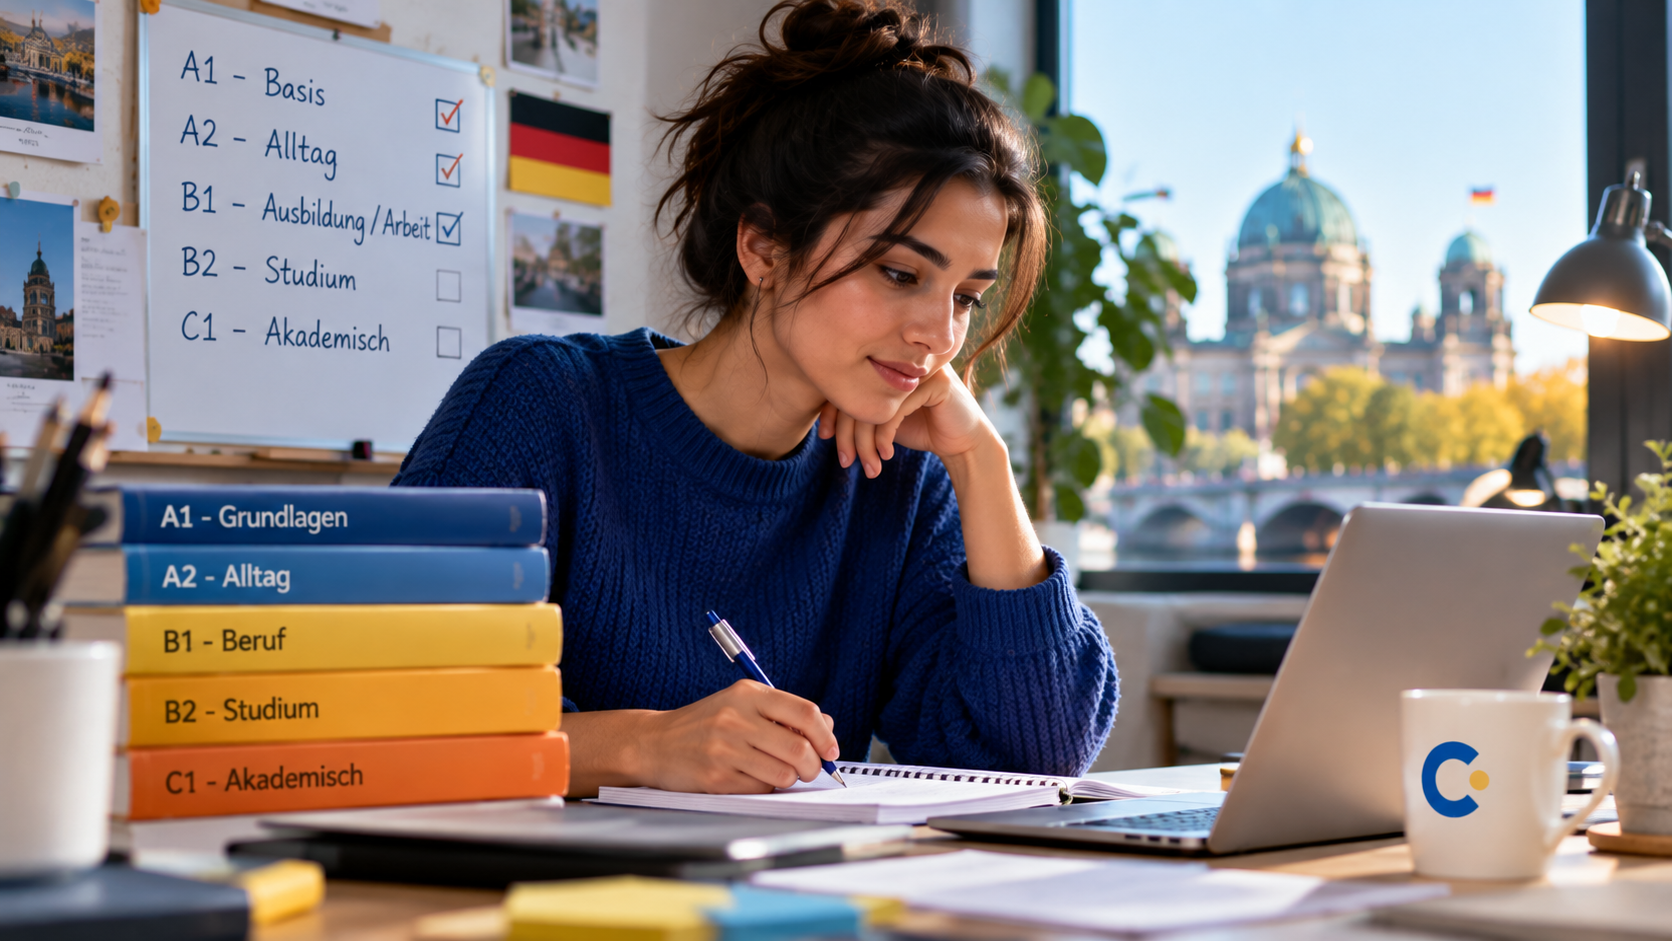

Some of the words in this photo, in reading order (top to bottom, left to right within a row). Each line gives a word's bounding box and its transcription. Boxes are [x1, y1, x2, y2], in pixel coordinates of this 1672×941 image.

[181, 50, 217, 84] A1
[265, 68, 324, 106] Basis
[180, 115, 218, 147] A2
[265, 129, 337, 181] Alltag
[182, 182, 216, 213] B1
[182, 246, 217, 277] B2
[265, 256, 356, 290] Studium
[182, 311, 216, 341] C1
[265, 316, 389, 352] Akademisch
[161, 505, 193, 528] A1
[219, 504, 347, 534] Grundlagen
[163, 565, 196, 587] A2
[223, 563, 290, 593] Alltag
[164, 630, 191, 653] B1
[223, 627, 286, 651] Beruf
[165, 700, 196, 724] B2
[224, 697, 318, 721] Studium
[166, 771, 195, 794] C1
[224, 763, 363, 792] Akademisch
